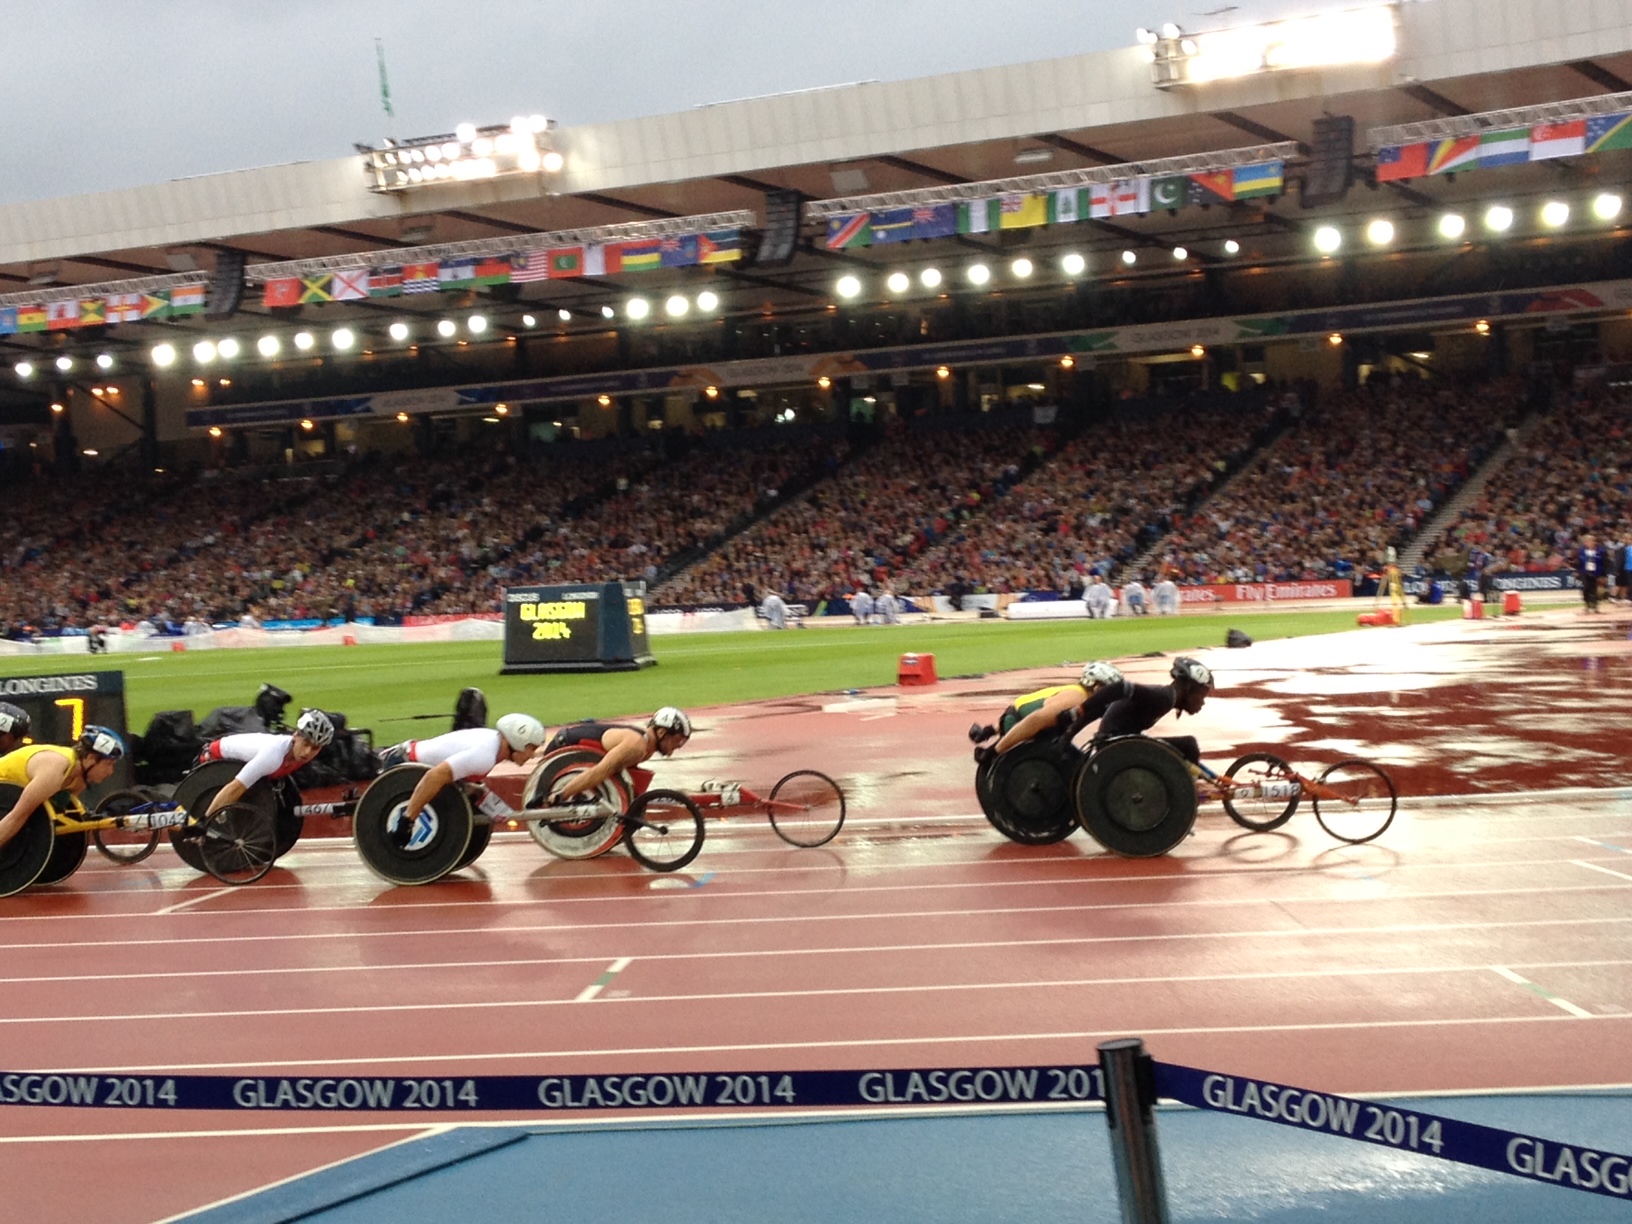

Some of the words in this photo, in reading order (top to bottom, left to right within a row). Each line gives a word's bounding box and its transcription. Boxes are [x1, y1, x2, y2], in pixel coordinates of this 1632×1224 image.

[1264, 582, 1338, 600] Emirates
[0, 1074, 99, 1105] SGOW
[103, 1077, 178, 1107] 2014
[233, 1078, 396, 1109] GLASGOW
[401, 1079, 478, 1109] 2014
[537, 1076, 707, 1107] GLASGOW
[714, 1074, 796, 1105] 2014
[858, 1069, 1040, 1102] GLASGOW
[1046, 1067, 1107, 1100] 201
[1202, 1074, 1359, 1134] GLASGOW
[1364, 1106, 1445, 1154] 2014
[1506, 1136, 1632, 1194] GLASG
